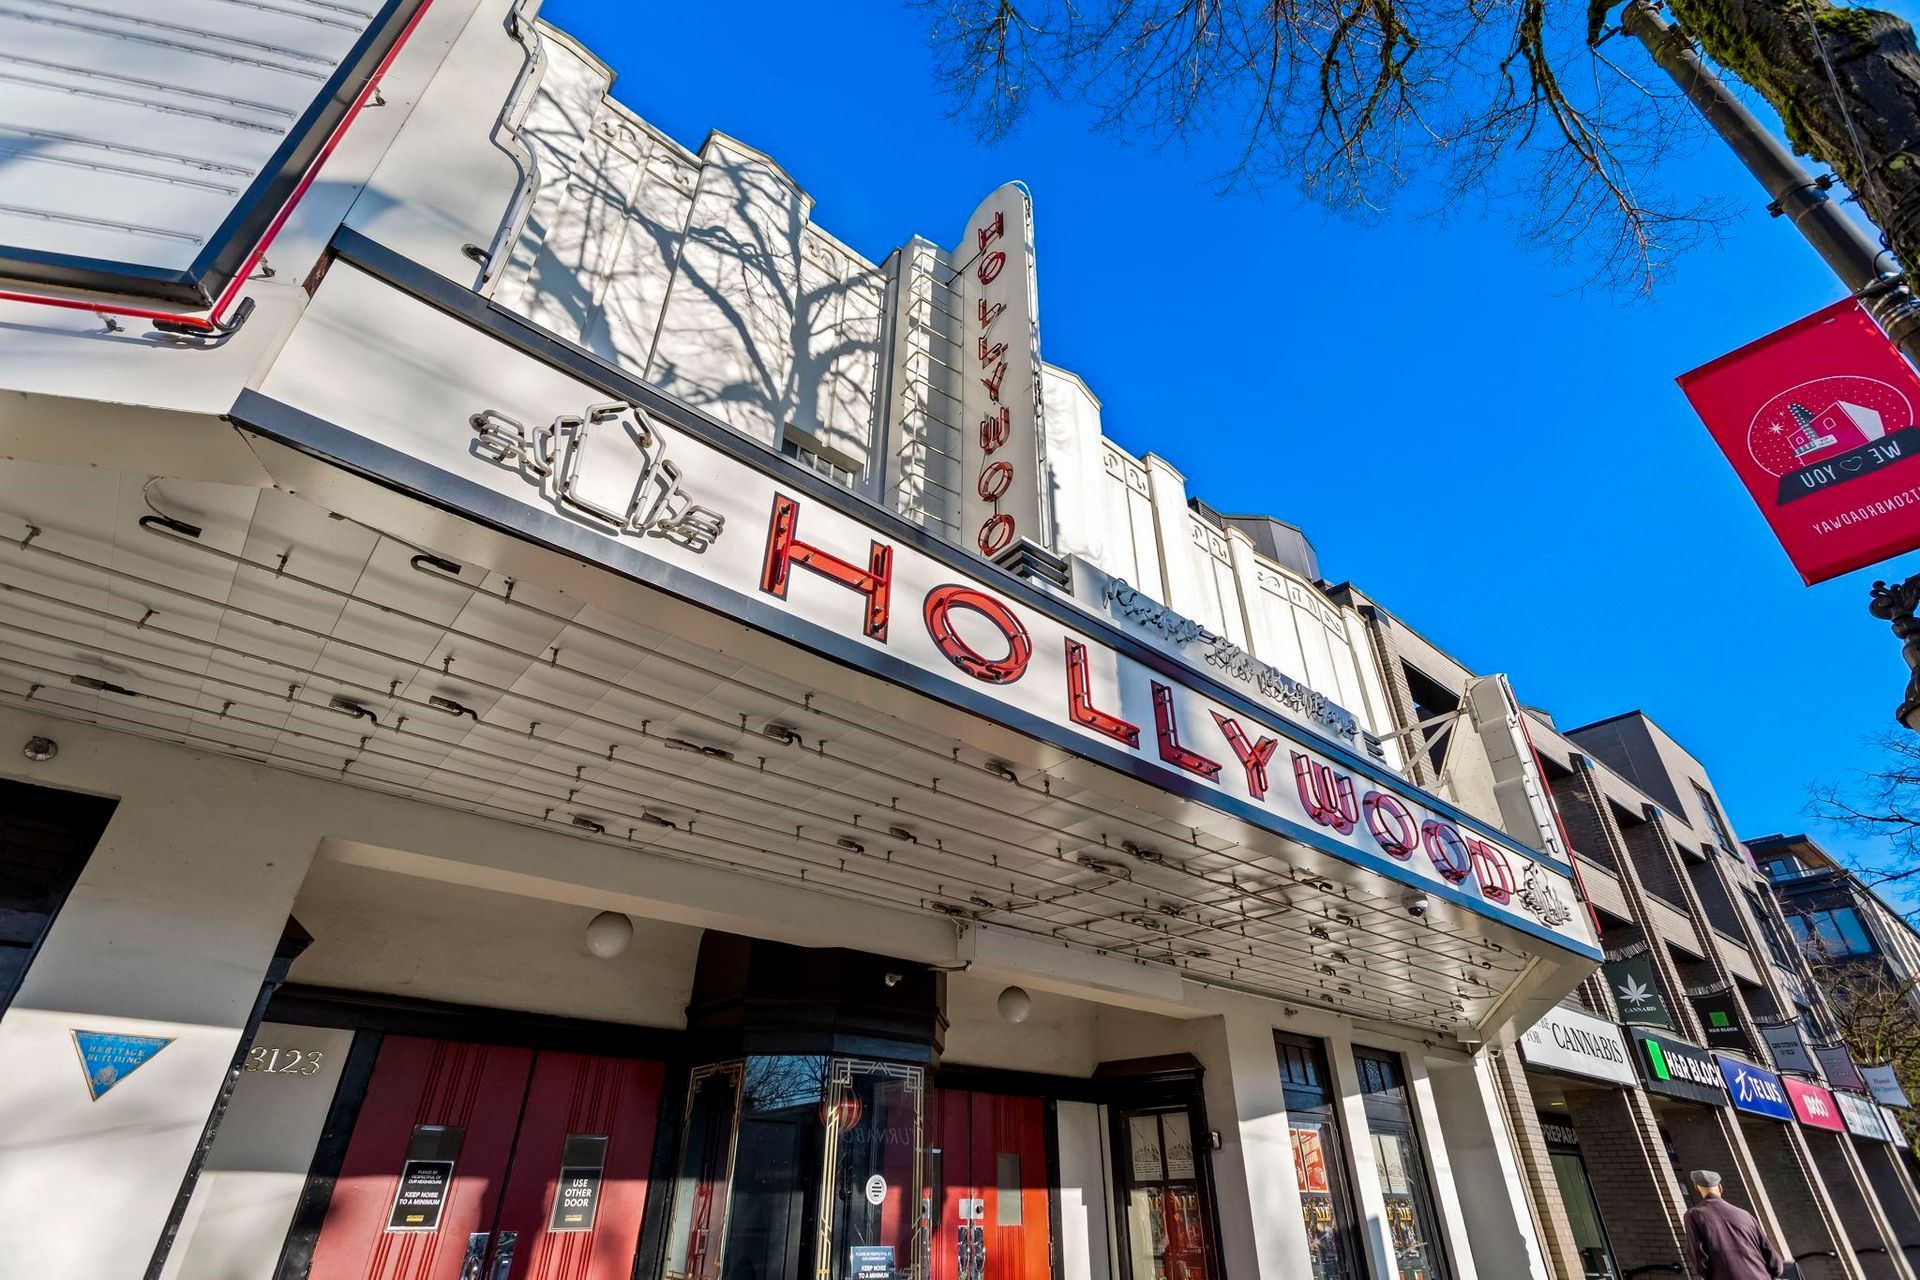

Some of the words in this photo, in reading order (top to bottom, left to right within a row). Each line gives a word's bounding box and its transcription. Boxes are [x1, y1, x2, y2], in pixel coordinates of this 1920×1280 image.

[977, 211, 1016, 556] HOLLYWOO
[759, 490, 1517, 906] HOLLYWOOD
[1624, 1005, 1657, 1014] CANNABIS
[1551, 1022, 1624, 1064] CANNABIS
[244, 1046, 323, 1076] 3123
[1663, 1050, 1692, 1080] H&R
[1687, 1056, 1728, 1089] BLOCK
[1748, 1076, 1782, 1104] TELUS
[1541, 1123, 1578, 1144] REPARA
[565, 1189, 592, 1197] OTHER
[573, 1179, 588, 1187] USE
[564, 1198, 589, 1207] DOOR
